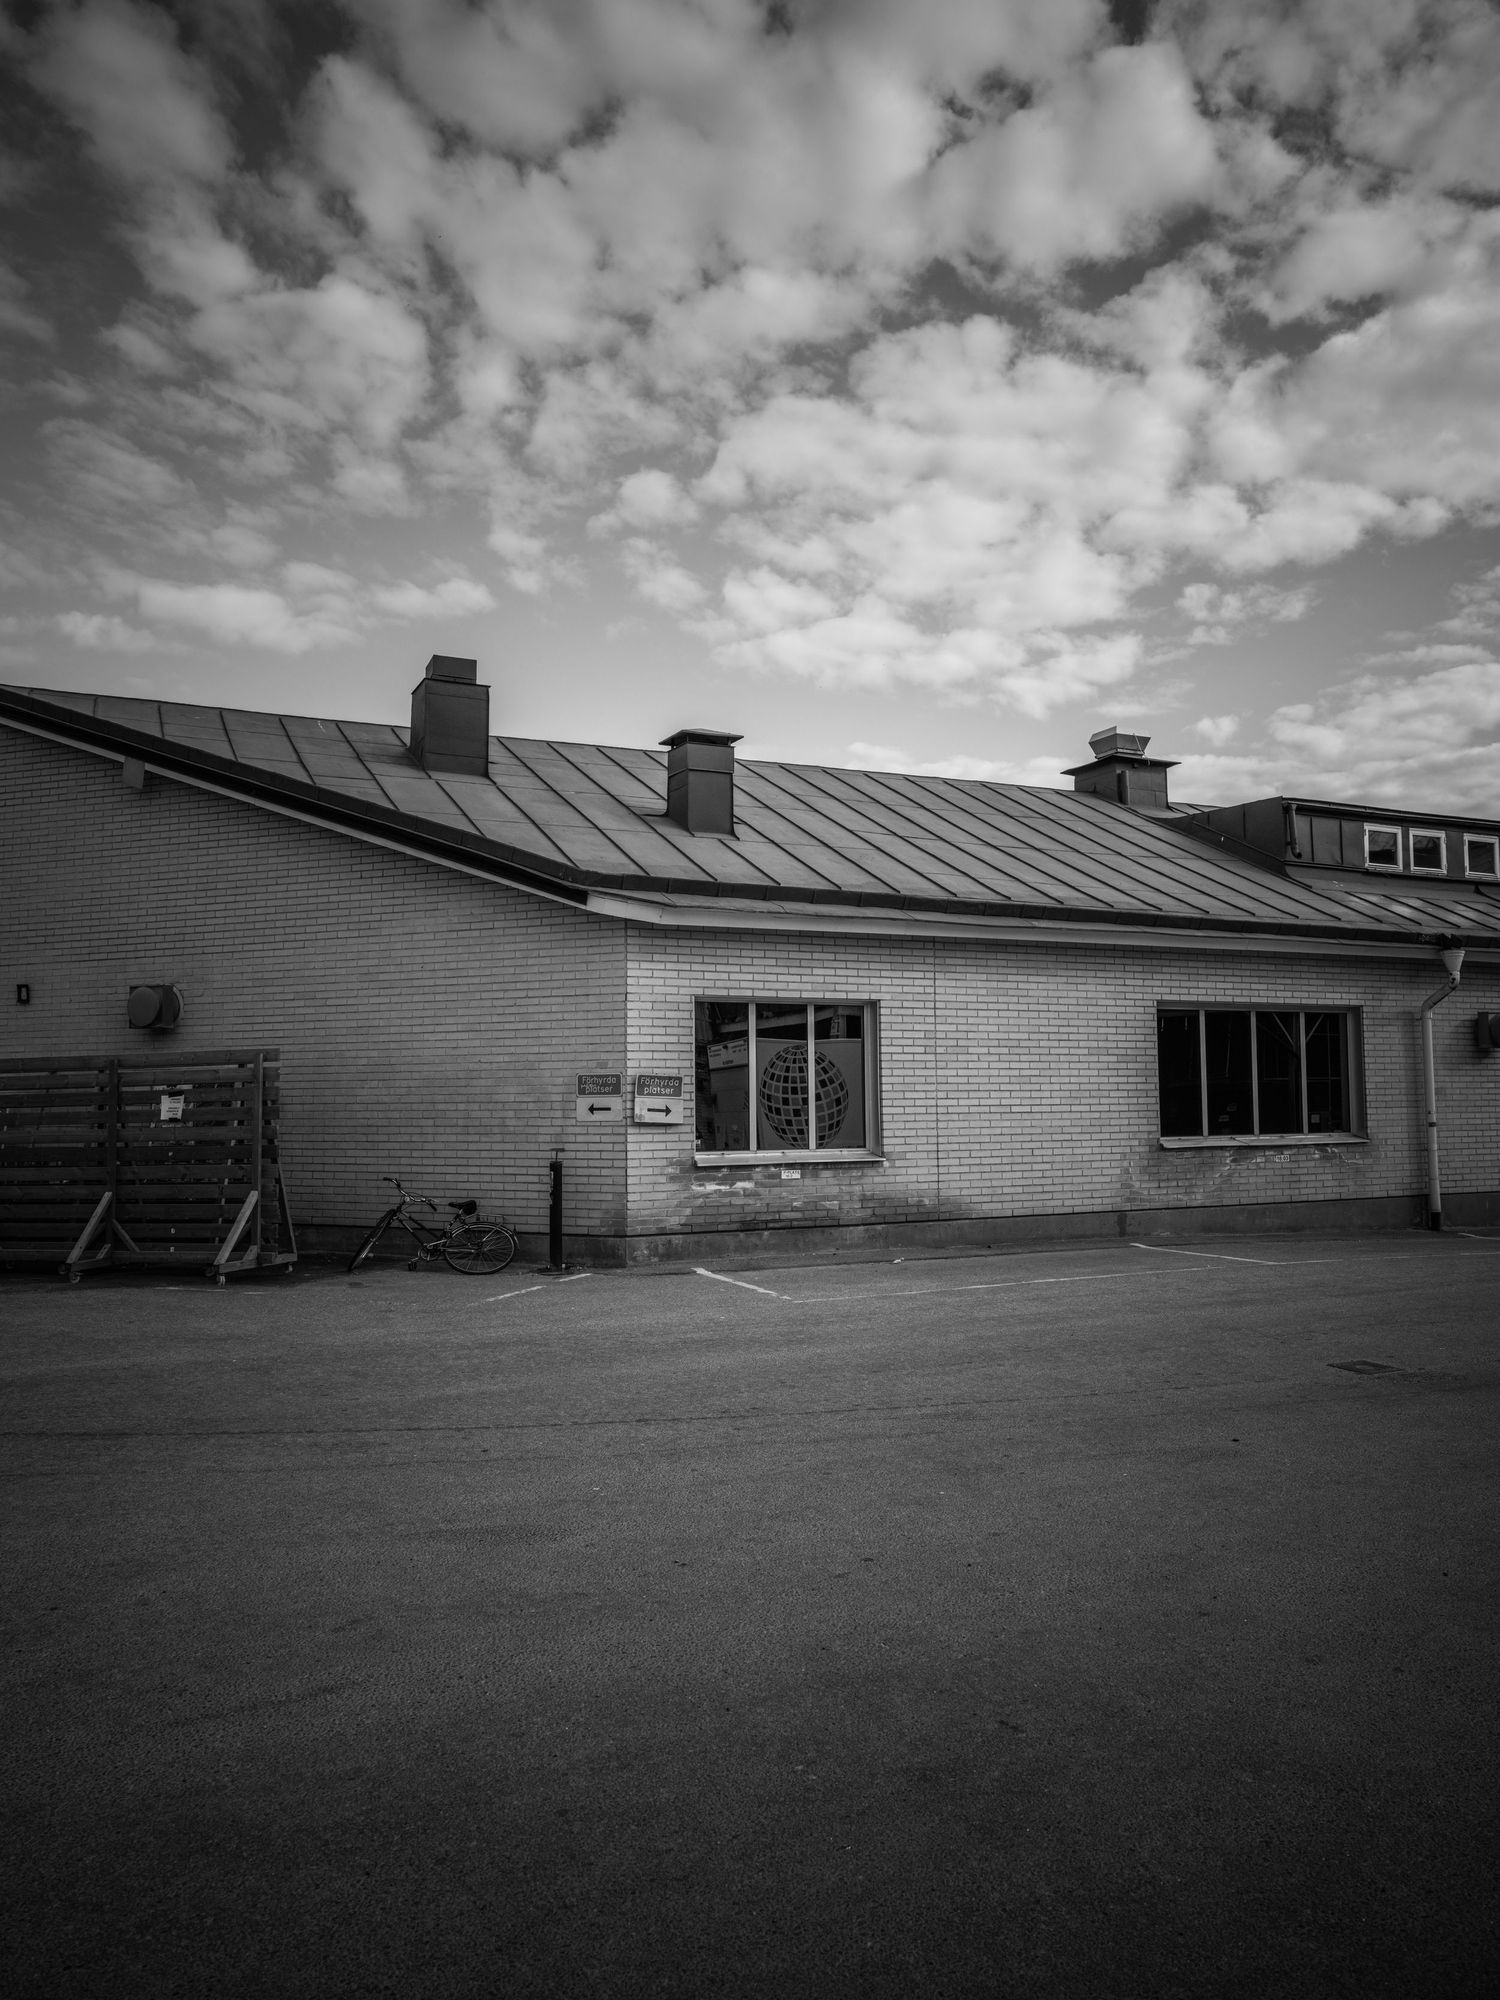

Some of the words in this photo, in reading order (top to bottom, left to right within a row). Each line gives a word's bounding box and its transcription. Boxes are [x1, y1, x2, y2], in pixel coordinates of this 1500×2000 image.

[582, 1076, 617, 1085] Förhyrda
[640, 1077, 680, 1087] Förhyrda
[585, 1085, 613, 1094] platser
[644, 1086, 675, 1095] platser
